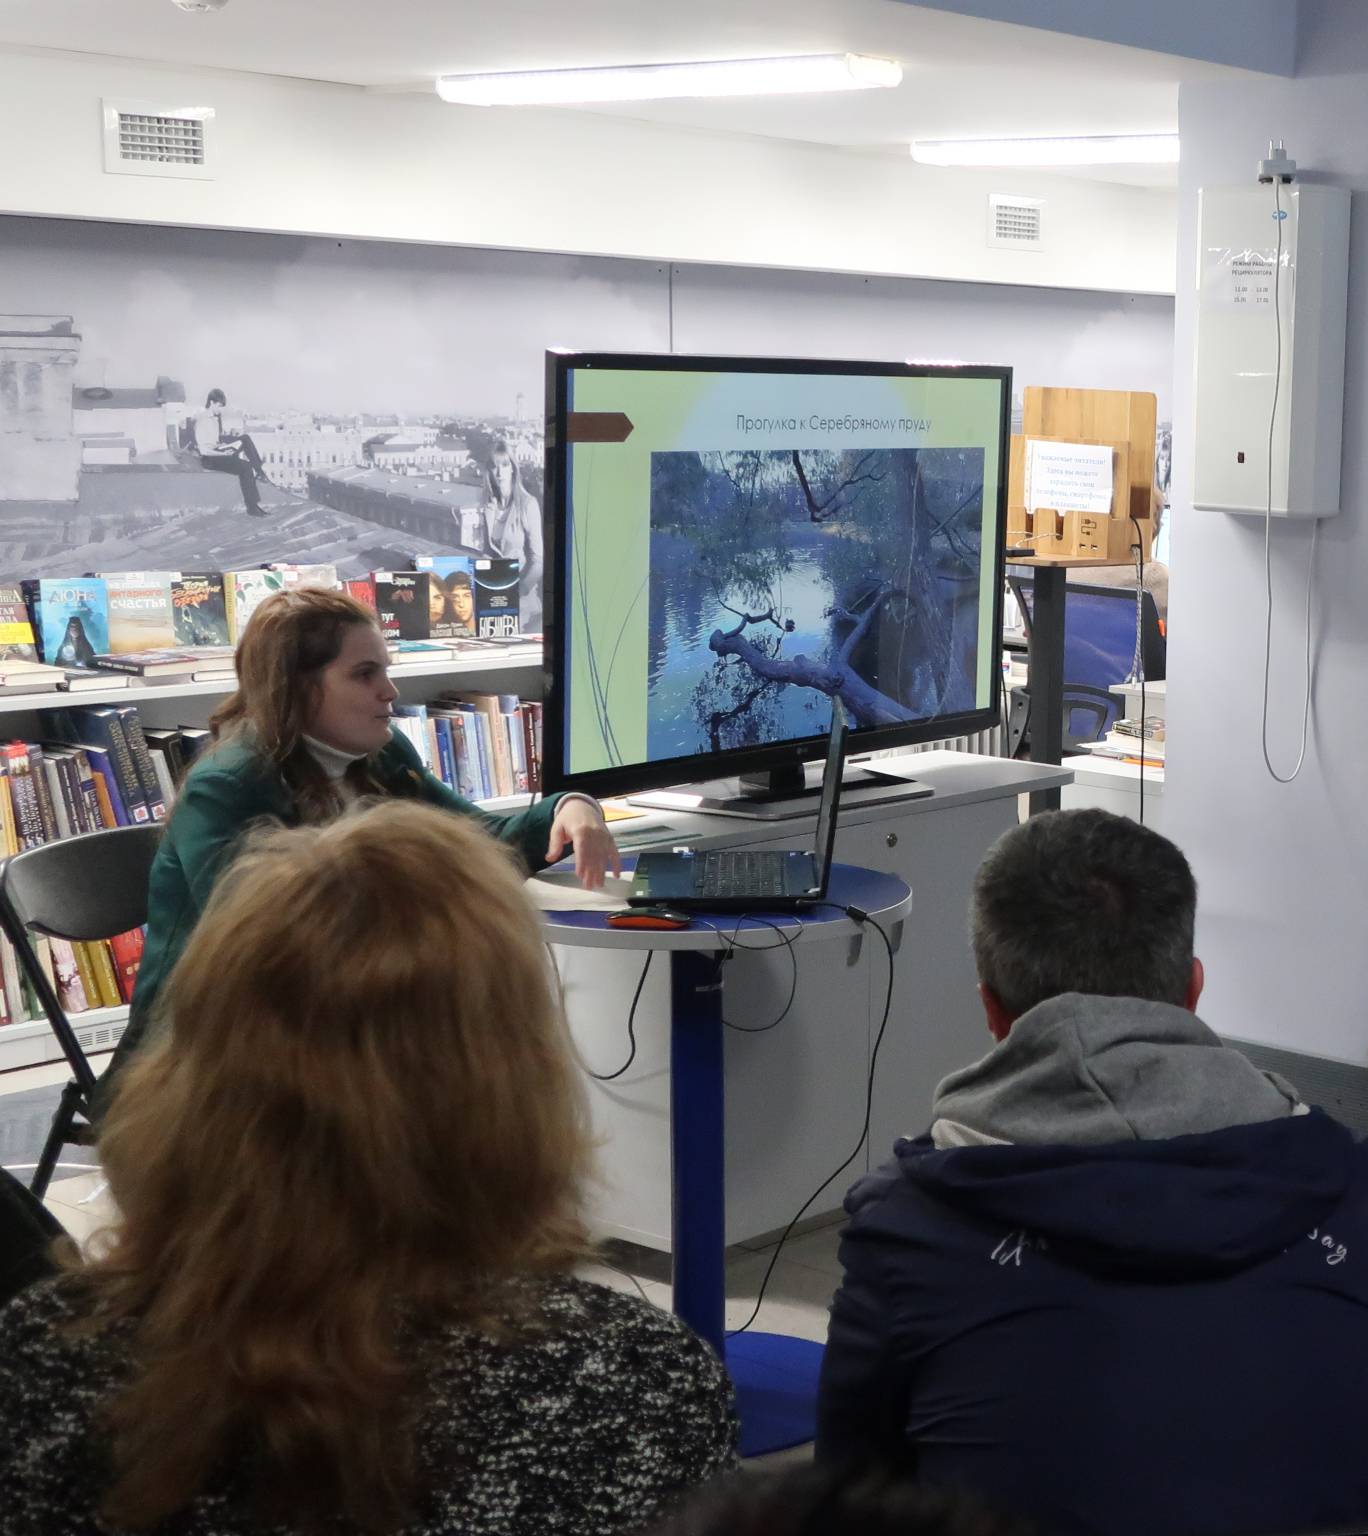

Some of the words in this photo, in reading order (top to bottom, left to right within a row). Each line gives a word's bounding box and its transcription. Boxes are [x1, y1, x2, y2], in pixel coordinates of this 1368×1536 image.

[736, 414, 796, 433] Прогулка
[799, 417, 807, 430] к
[809, 414, 895, 433] Серебряному
[898, 417, 932, 433] пруду
